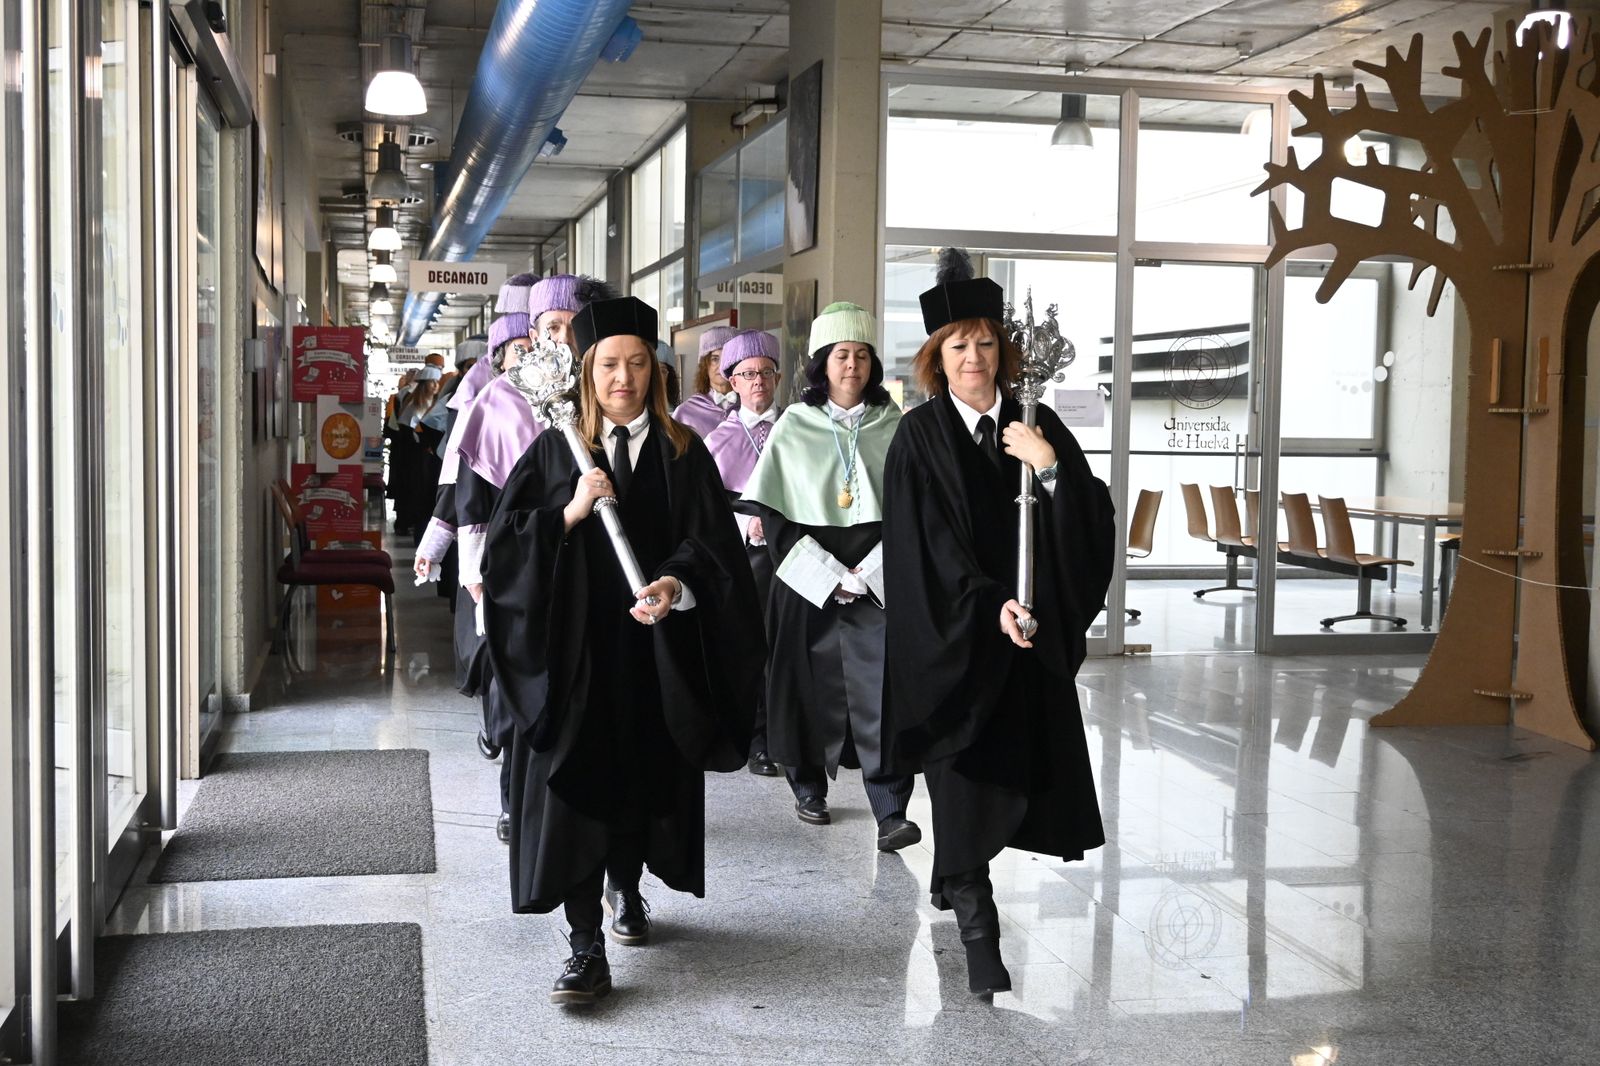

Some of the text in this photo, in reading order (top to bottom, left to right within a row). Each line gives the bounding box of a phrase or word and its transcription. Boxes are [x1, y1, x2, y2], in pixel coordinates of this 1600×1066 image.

[428, 270, 489, 285] DECANATO
[1167, 432, 1230, 450] de Huelva
